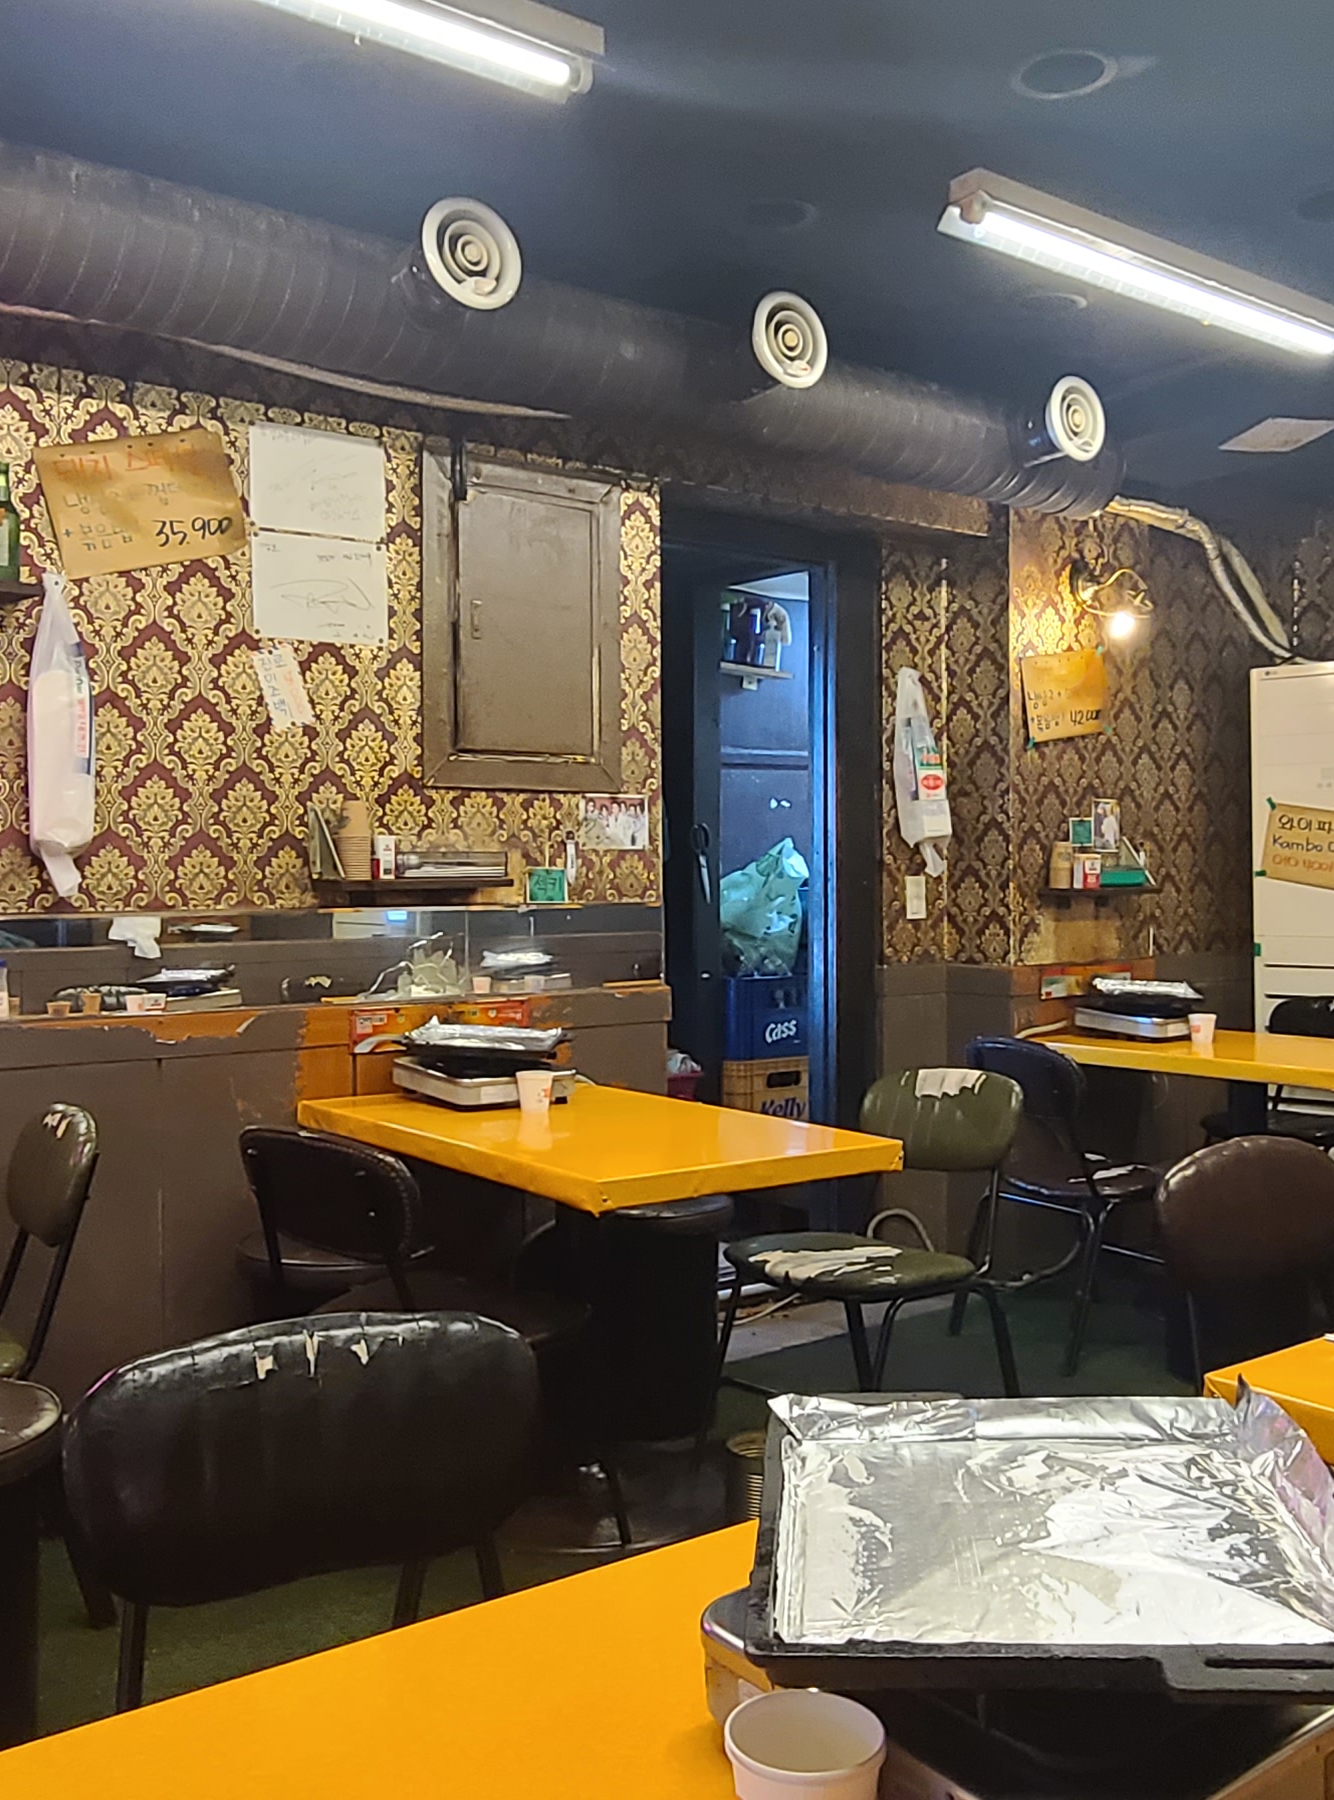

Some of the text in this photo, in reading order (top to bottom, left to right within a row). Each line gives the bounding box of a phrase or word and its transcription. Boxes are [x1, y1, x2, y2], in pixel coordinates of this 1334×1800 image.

[1271, 833, 1324, 853] Kambo
[764, 1019, 798, 1044] Cass
[759, 1096, 807, 1119] Kelly
